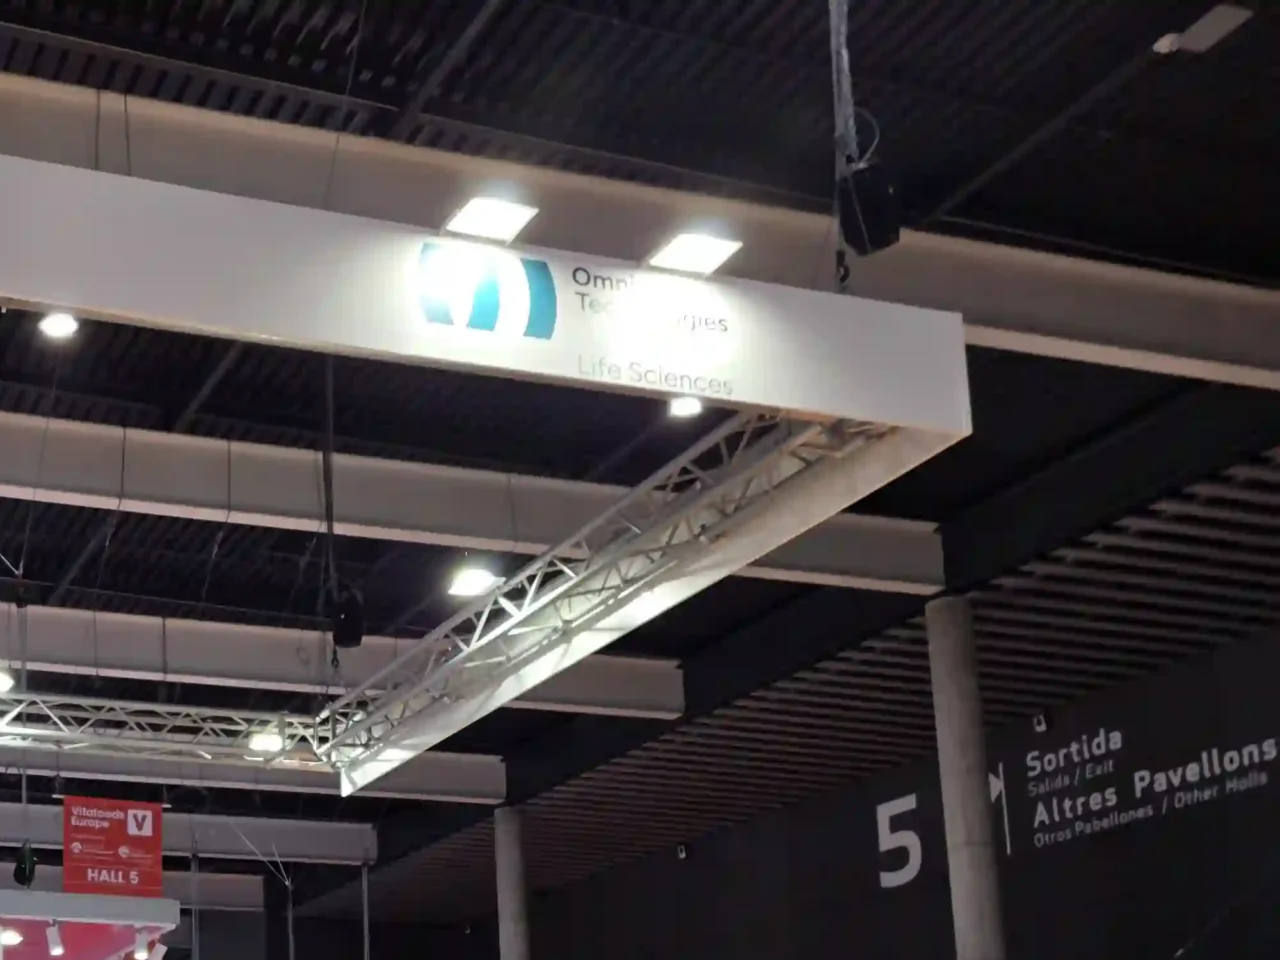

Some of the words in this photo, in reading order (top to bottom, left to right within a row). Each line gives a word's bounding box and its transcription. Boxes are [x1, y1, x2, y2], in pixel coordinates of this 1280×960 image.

[572, 266, 636, 291] Omn
[578, 354, 621, 381] Life
[629, 362, 733, 396] Sciences
[1026, 727, 1122, 777] Sortida
[1033, 786, 1117, 828] Altres
[1133, 737, 1279, 798] Pavellons
[876, 793, 922, 889] 5
[1034, 828, 1072, 848] Otros
[87, 868, 126, 883] HALL
[129, 871, 139, 884] 5
